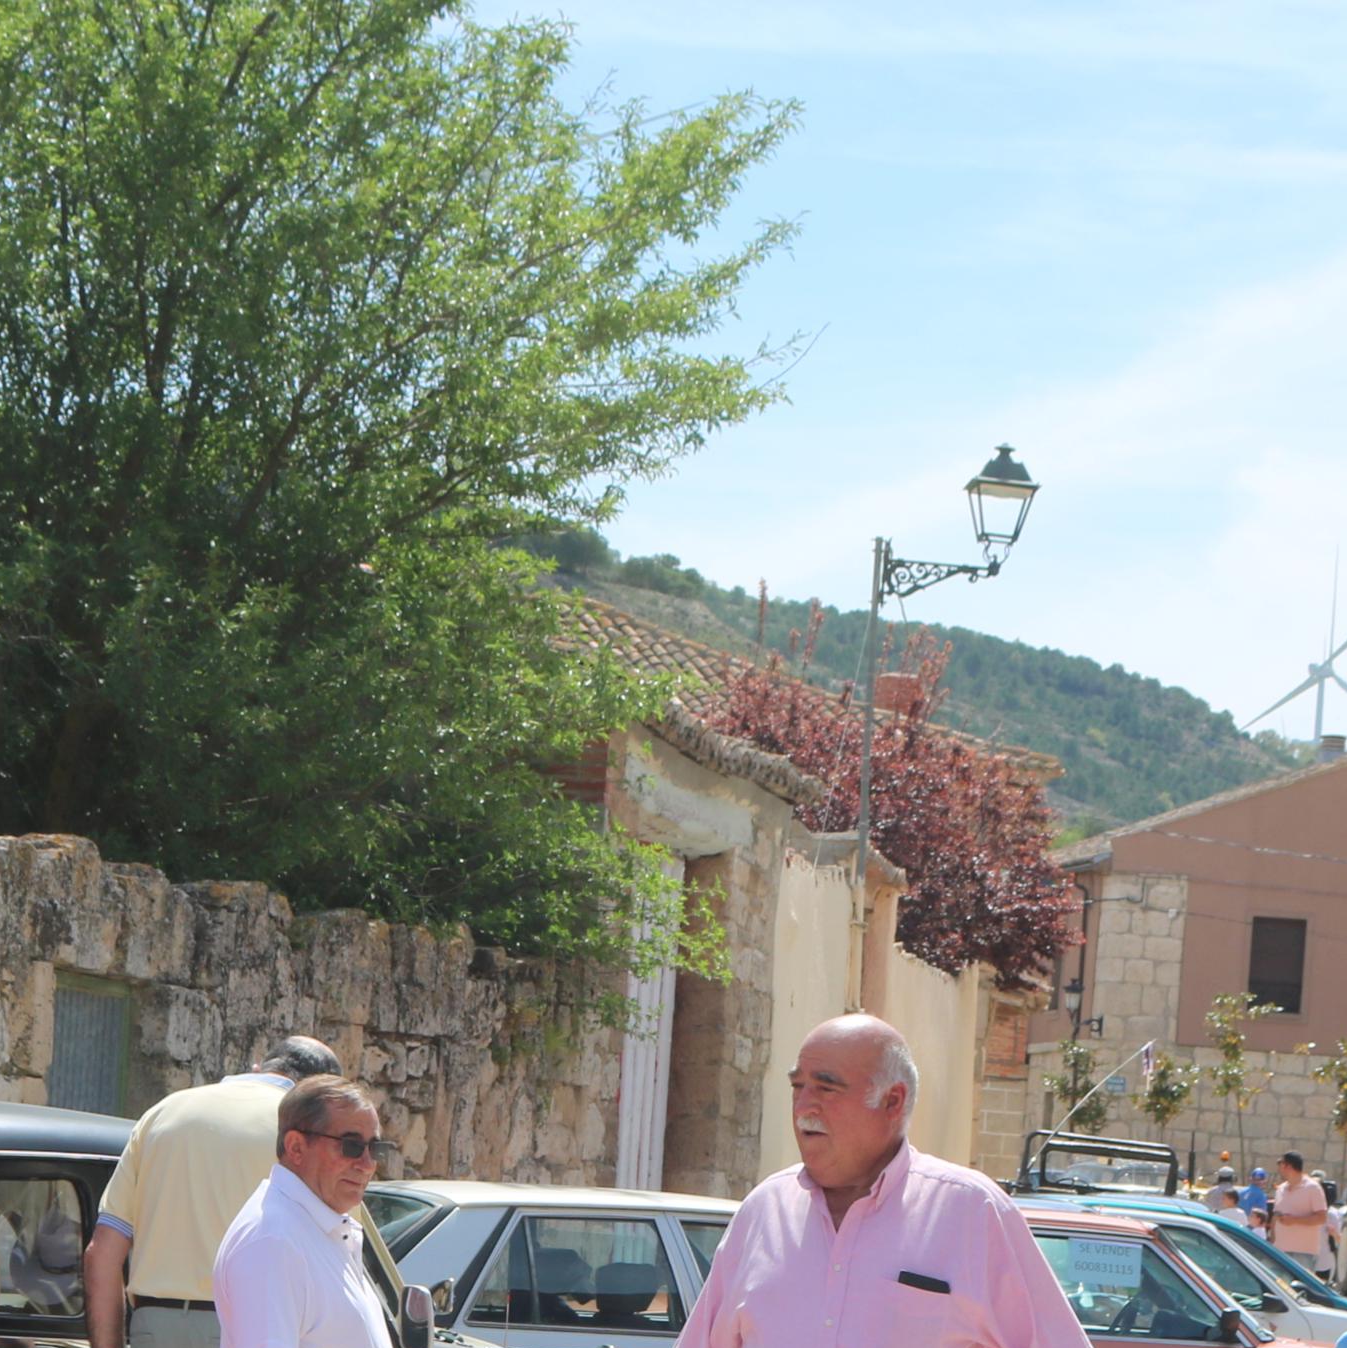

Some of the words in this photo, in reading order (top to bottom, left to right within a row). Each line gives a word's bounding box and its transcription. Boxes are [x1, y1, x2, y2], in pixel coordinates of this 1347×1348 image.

[1078, 1243, 1091, 1254] SE
[1094, 1244, 1132, 1257] VENDE
[1074, 1261, 1134, 1275] 600831115
